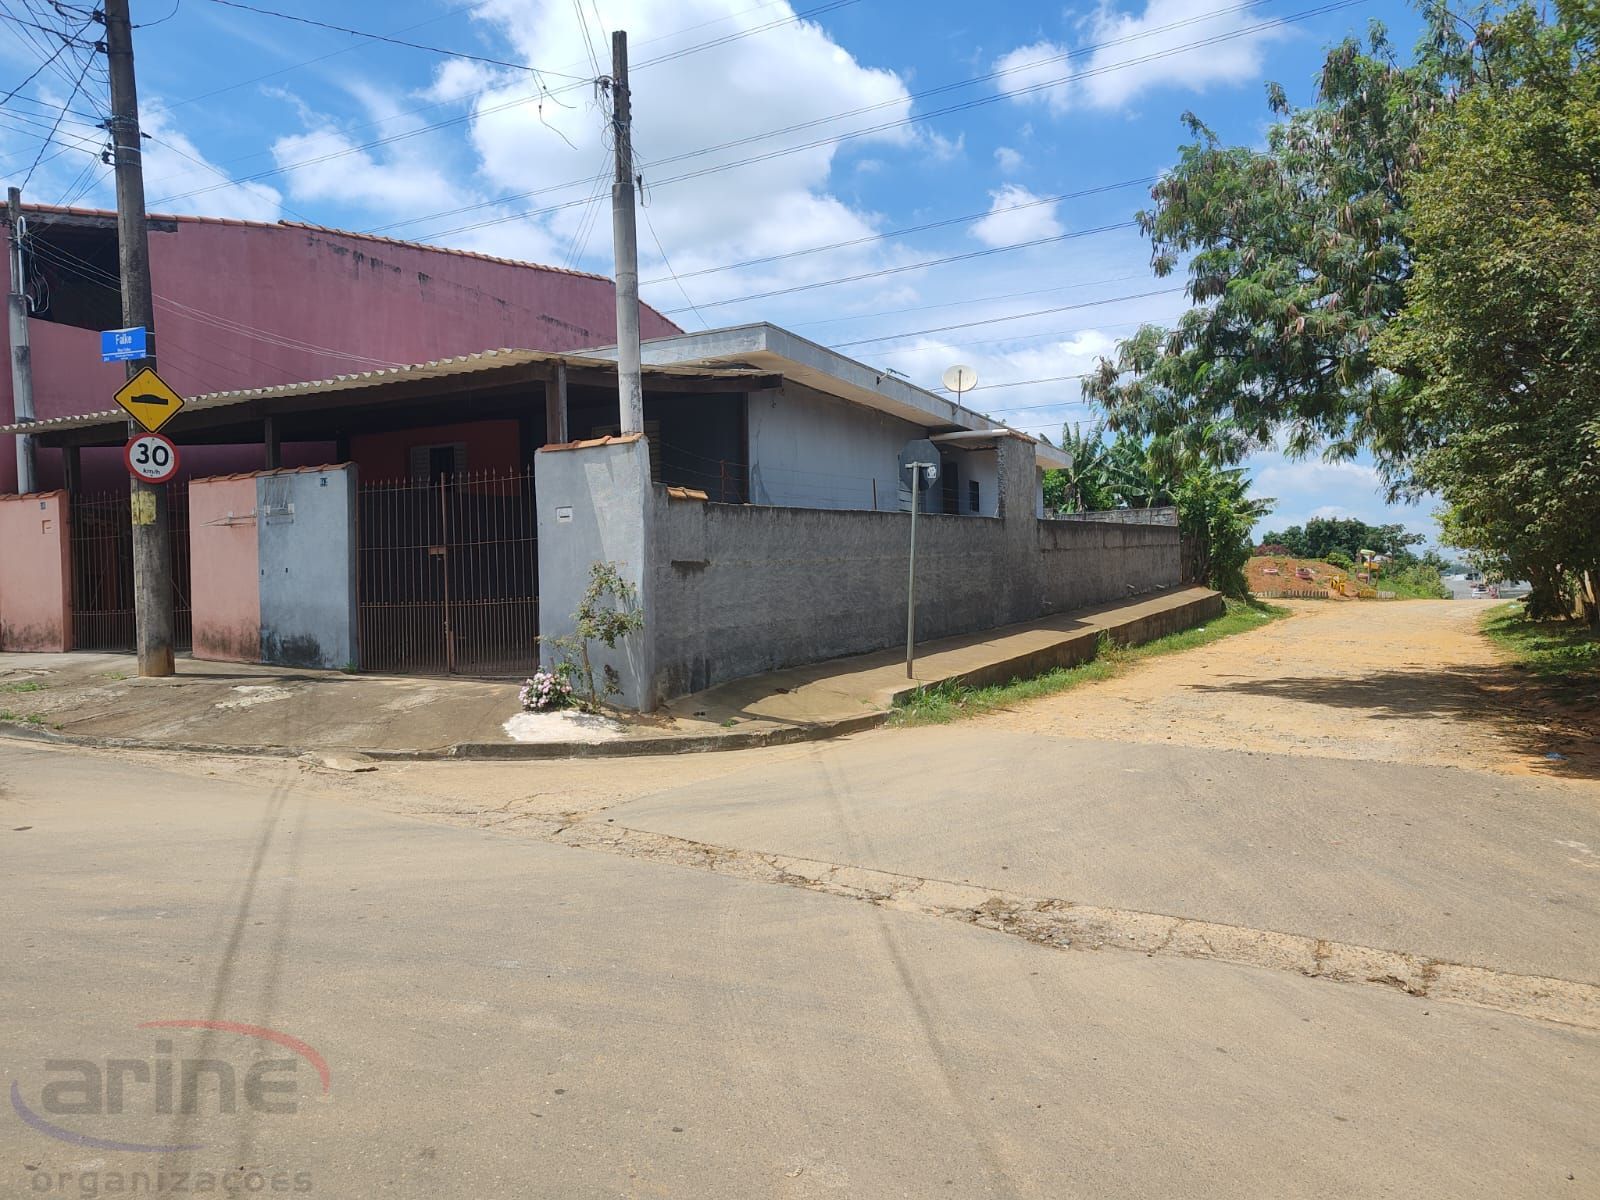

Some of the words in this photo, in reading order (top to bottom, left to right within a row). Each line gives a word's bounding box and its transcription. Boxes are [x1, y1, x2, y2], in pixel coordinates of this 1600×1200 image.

[115, 333, 133, 345] Falke
[136, 443, 169, 467] 30
[141, 468, 161, 476] km/h
